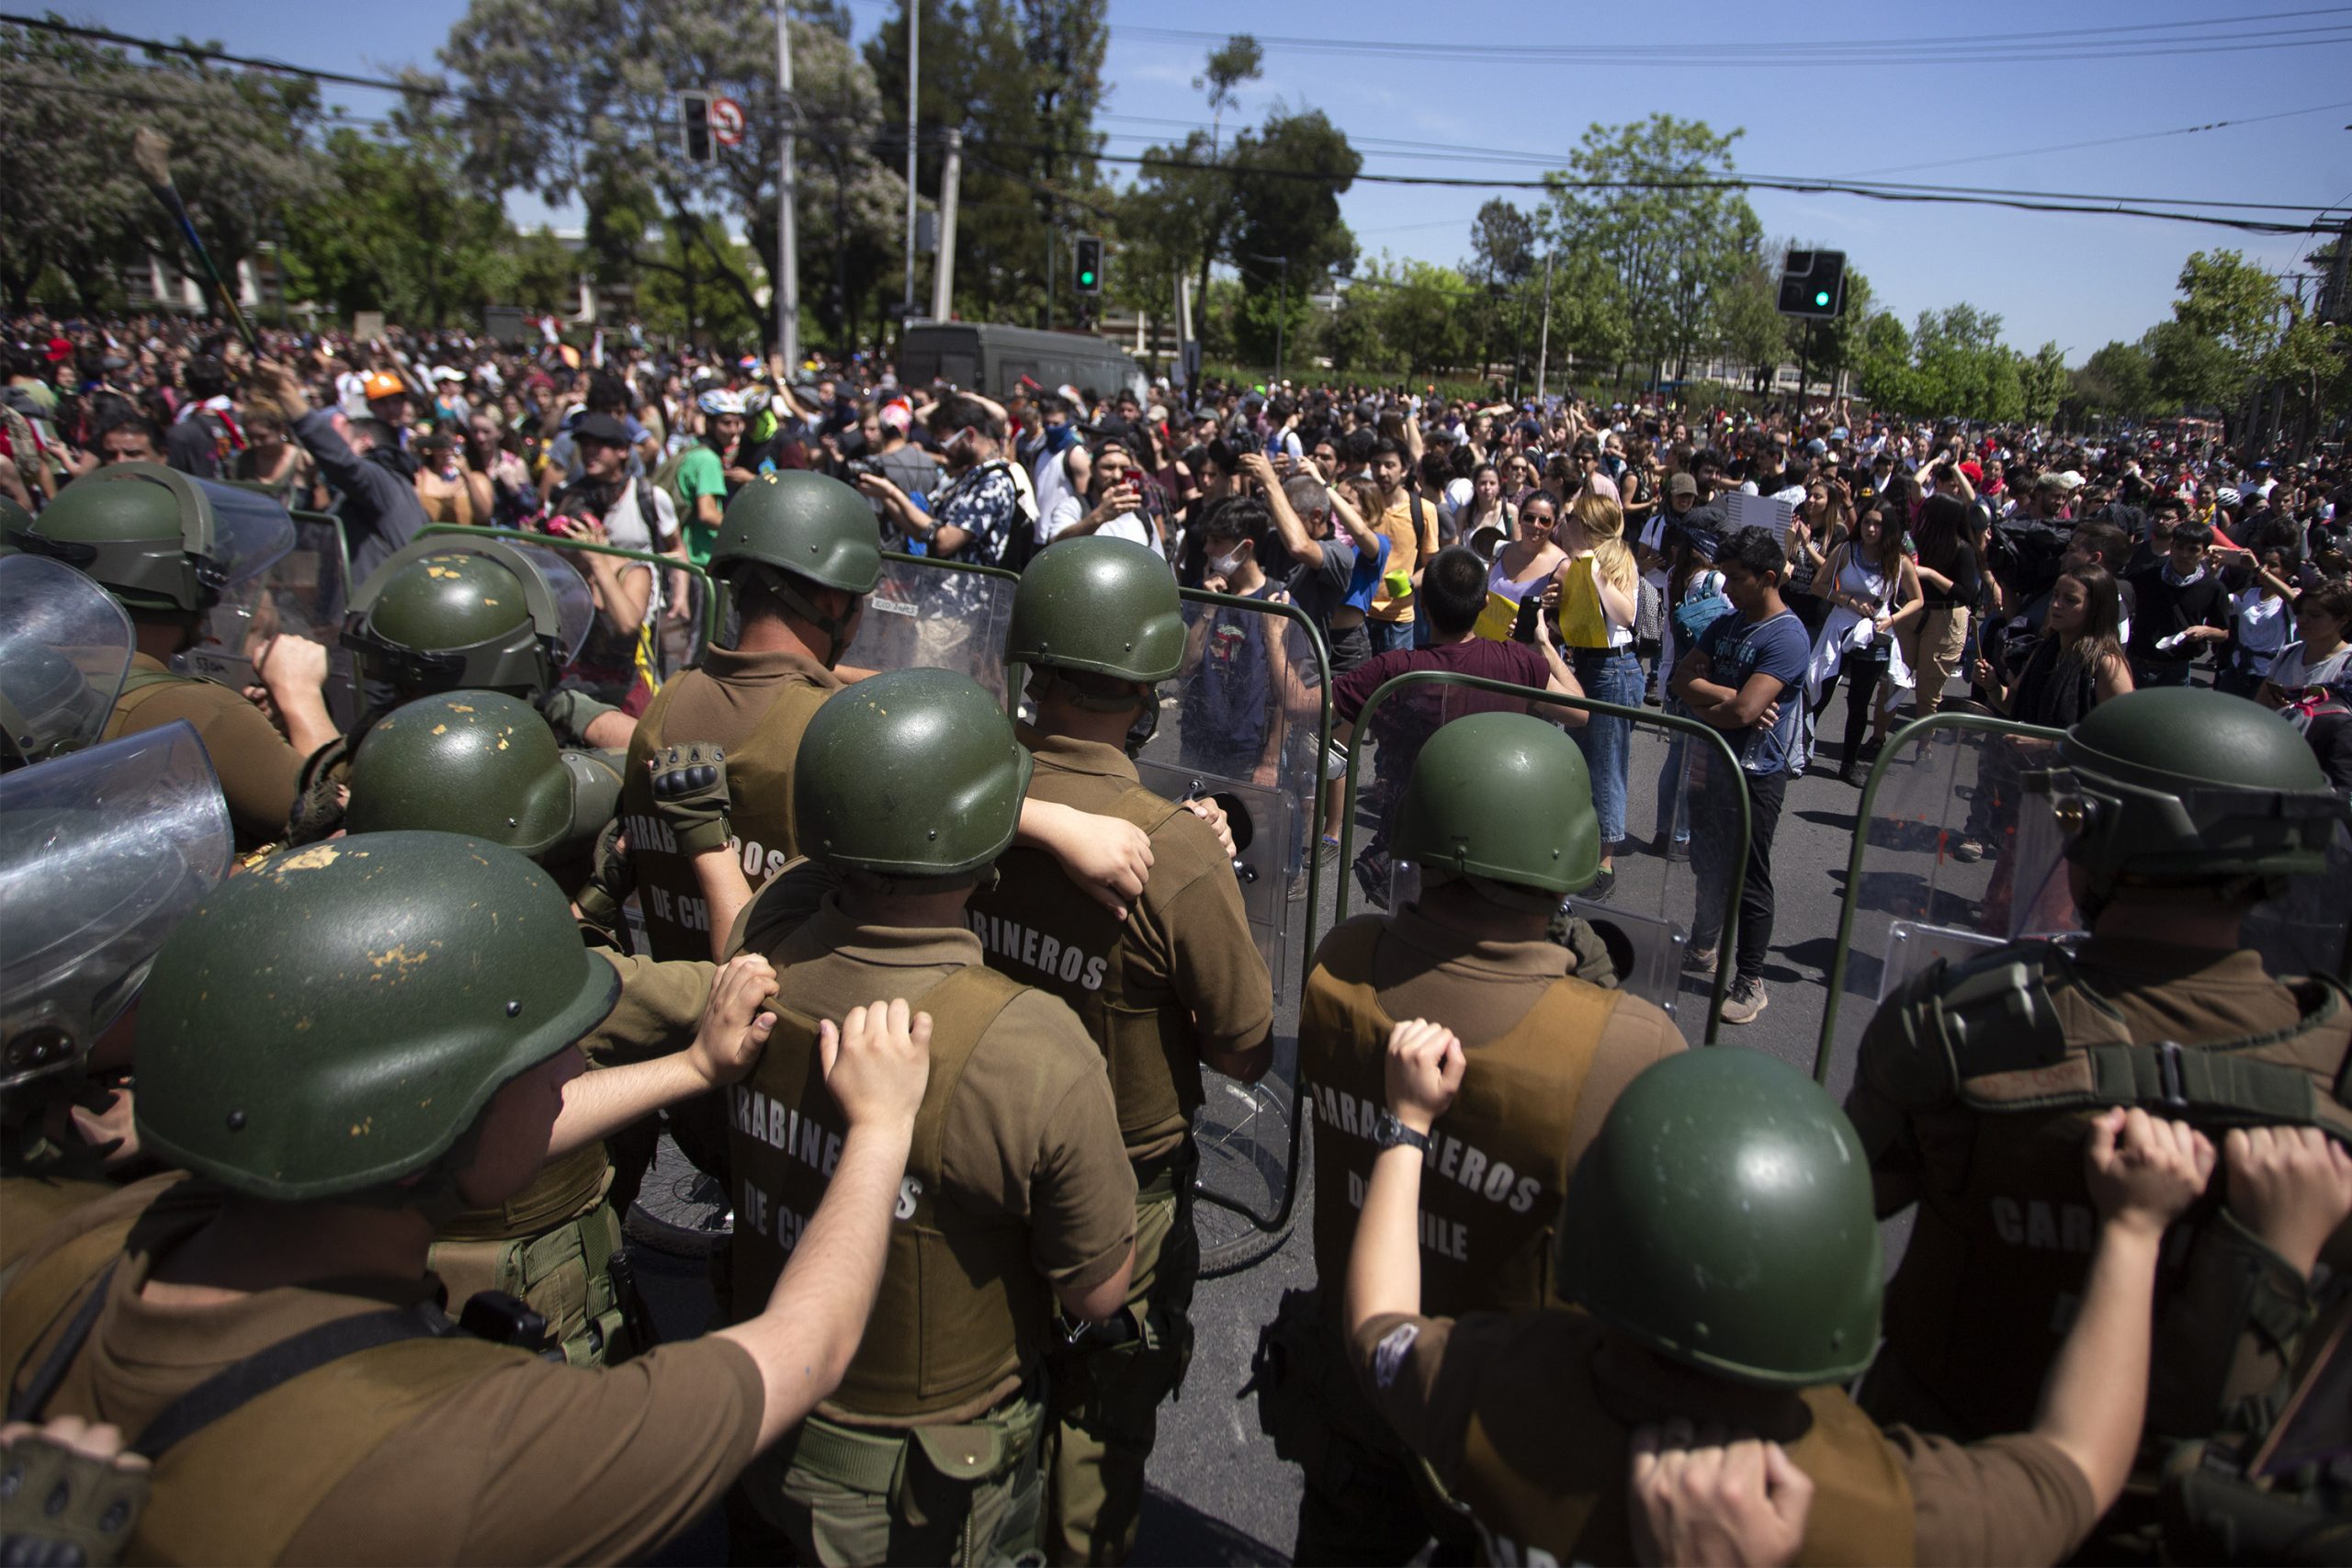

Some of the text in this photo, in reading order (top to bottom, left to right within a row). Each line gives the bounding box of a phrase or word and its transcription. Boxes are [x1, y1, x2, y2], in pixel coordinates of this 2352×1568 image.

[650, 885, 674, 922] DE
[966, 909, 1107, 990] BINEROS
[744, 1179, 768, 1236] DE
[1349, 1169, 1468, 1261] D ILE
